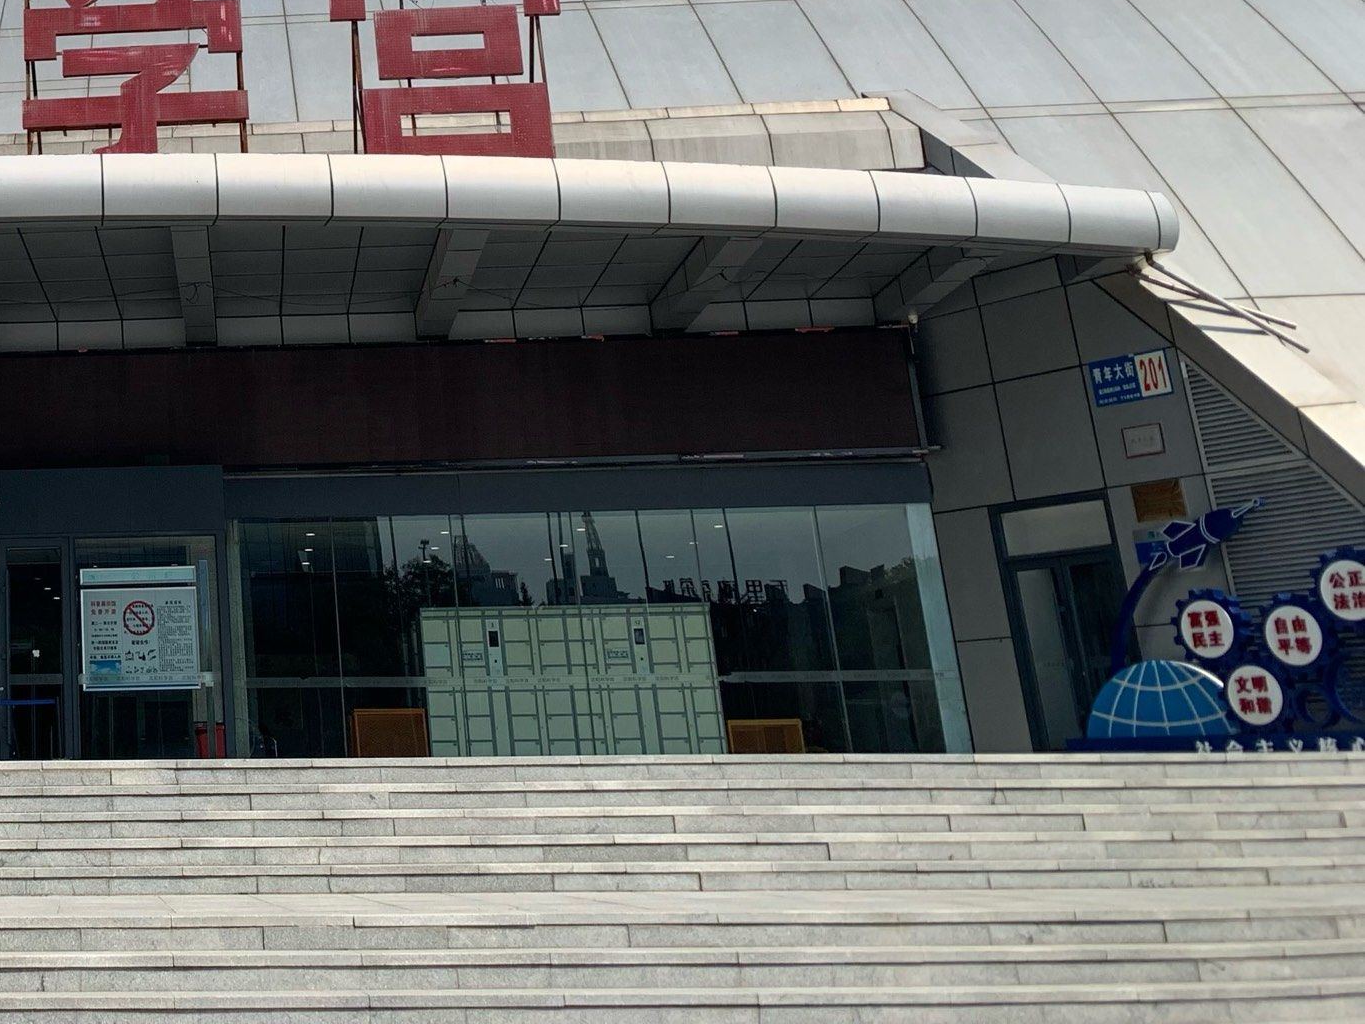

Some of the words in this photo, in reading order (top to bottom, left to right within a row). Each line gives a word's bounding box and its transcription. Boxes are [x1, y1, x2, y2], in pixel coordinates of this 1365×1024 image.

[1092, 361, 1135, 384] 青年大街
[1139, 356, 1168, 391] 201
[1329, 571, 1365, 588] 公正
[1187, 610, 1220, 629] 富强
[1274, 615, 1307, 635] 自由
[1192, 631, 1224, 649] 民主
[1277, 637, 1312, 655] 平等
[1235, 676, 1269, 693] 文明
[1239, 697, 1272, 715] 和谐
